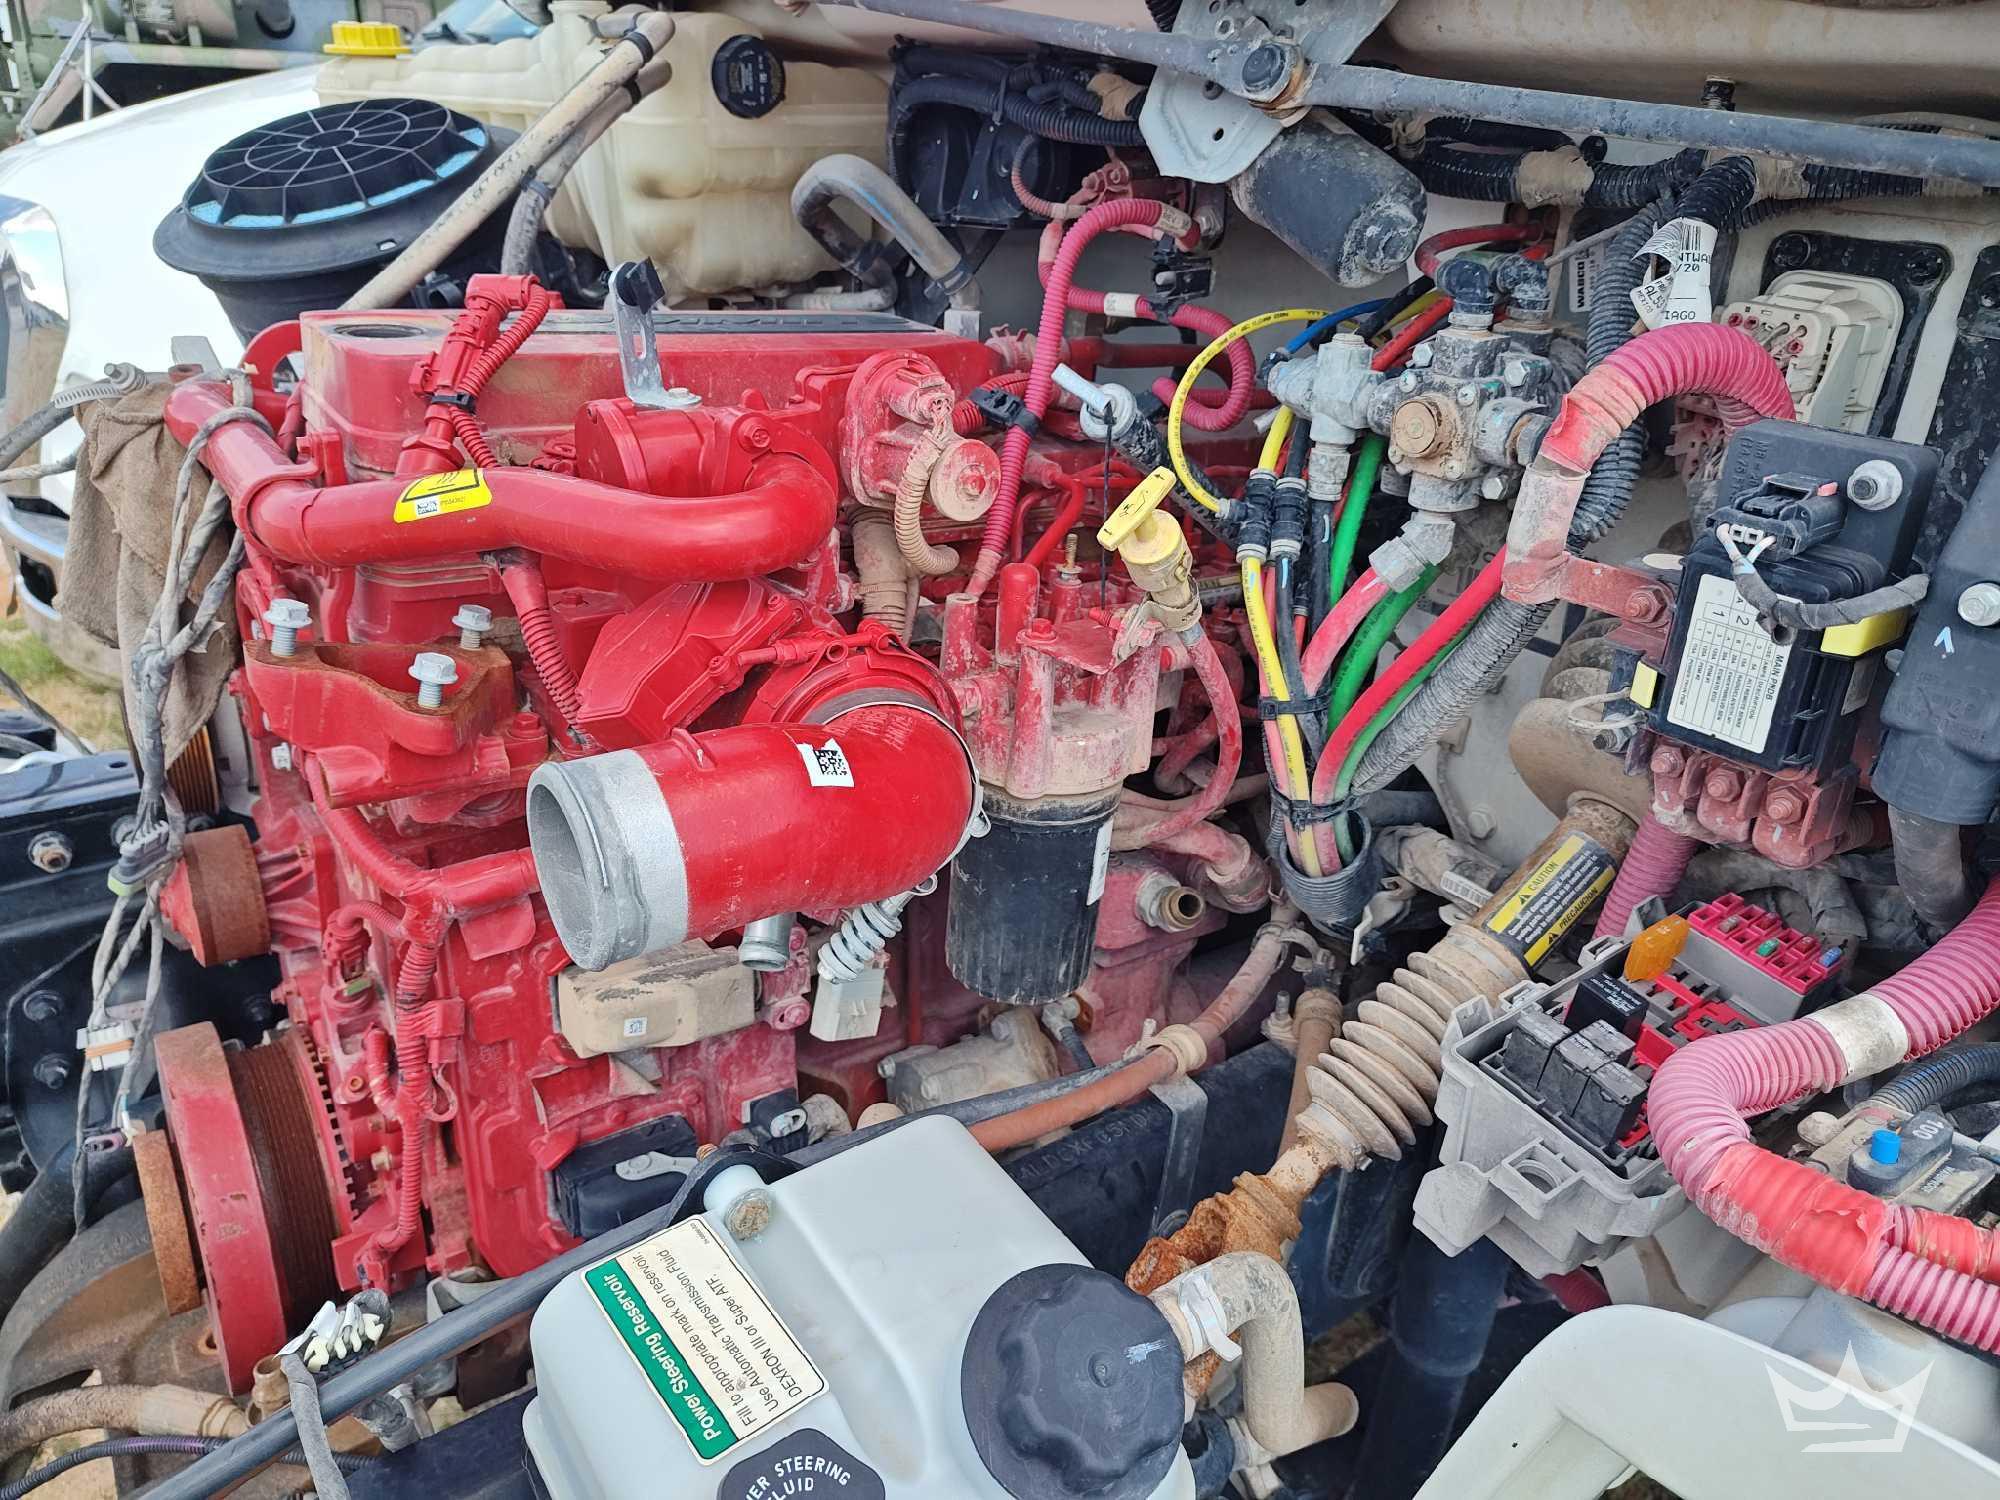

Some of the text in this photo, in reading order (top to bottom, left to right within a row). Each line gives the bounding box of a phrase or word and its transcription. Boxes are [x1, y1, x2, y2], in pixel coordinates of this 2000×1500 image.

[1576, 261, 1584, 308] WABCO
[1712, 609, 1724, 617] 1
[1735, 596, 1743, 604] A
[1735, 615, 1750, 626] 2
[1764, 654, 1784, 701] MAIN PNDB
[1526, 859, 1559, 892] CAUTION
[1912, 1119, 1944, 1139] 100
[656, 1247, 681, 1275] Fluid
[675, 1270, 726, 1338] Transmission
[631, 1250, 758, 1427] Fill to appropriate mark on reservoir.
[705, 1273, 803, 1400] DEXRON III or Super ATF.
[601, 1270, 723, 1443] Power Steering Reservoir
[719, 1334, 763, 1389] Automatic
[757, 1385, 780, 1412] Use
[774, 1455, 850, 1485] STEERING
